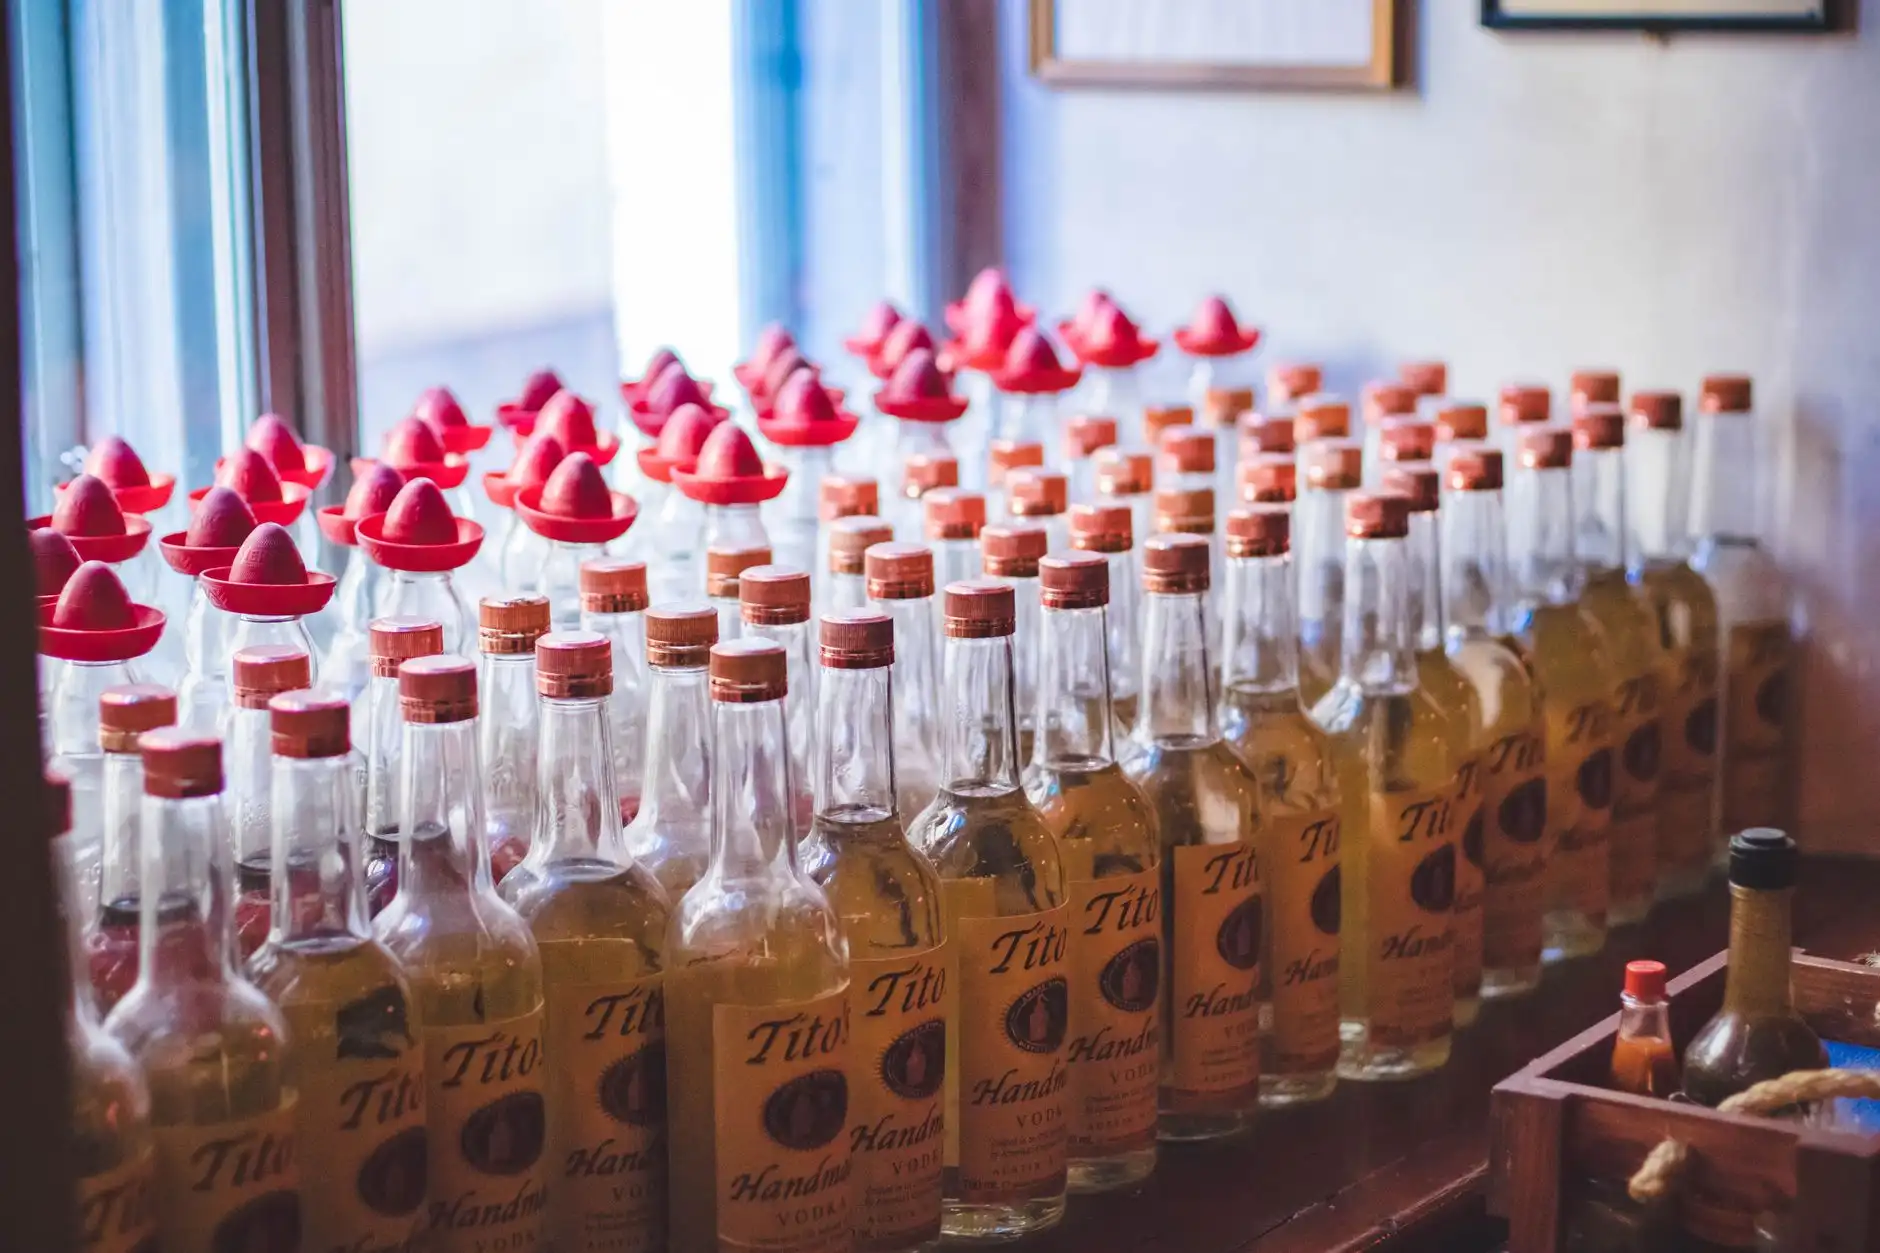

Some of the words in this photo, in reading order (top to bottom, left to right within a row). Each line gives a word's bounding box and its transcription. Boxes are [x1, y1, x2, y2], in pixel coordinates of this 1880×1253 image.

[1083, 884, 1158, 936] Tito
[989, 920, 1067, 974] Tito
[866, 960, 946, 1016] Tito
